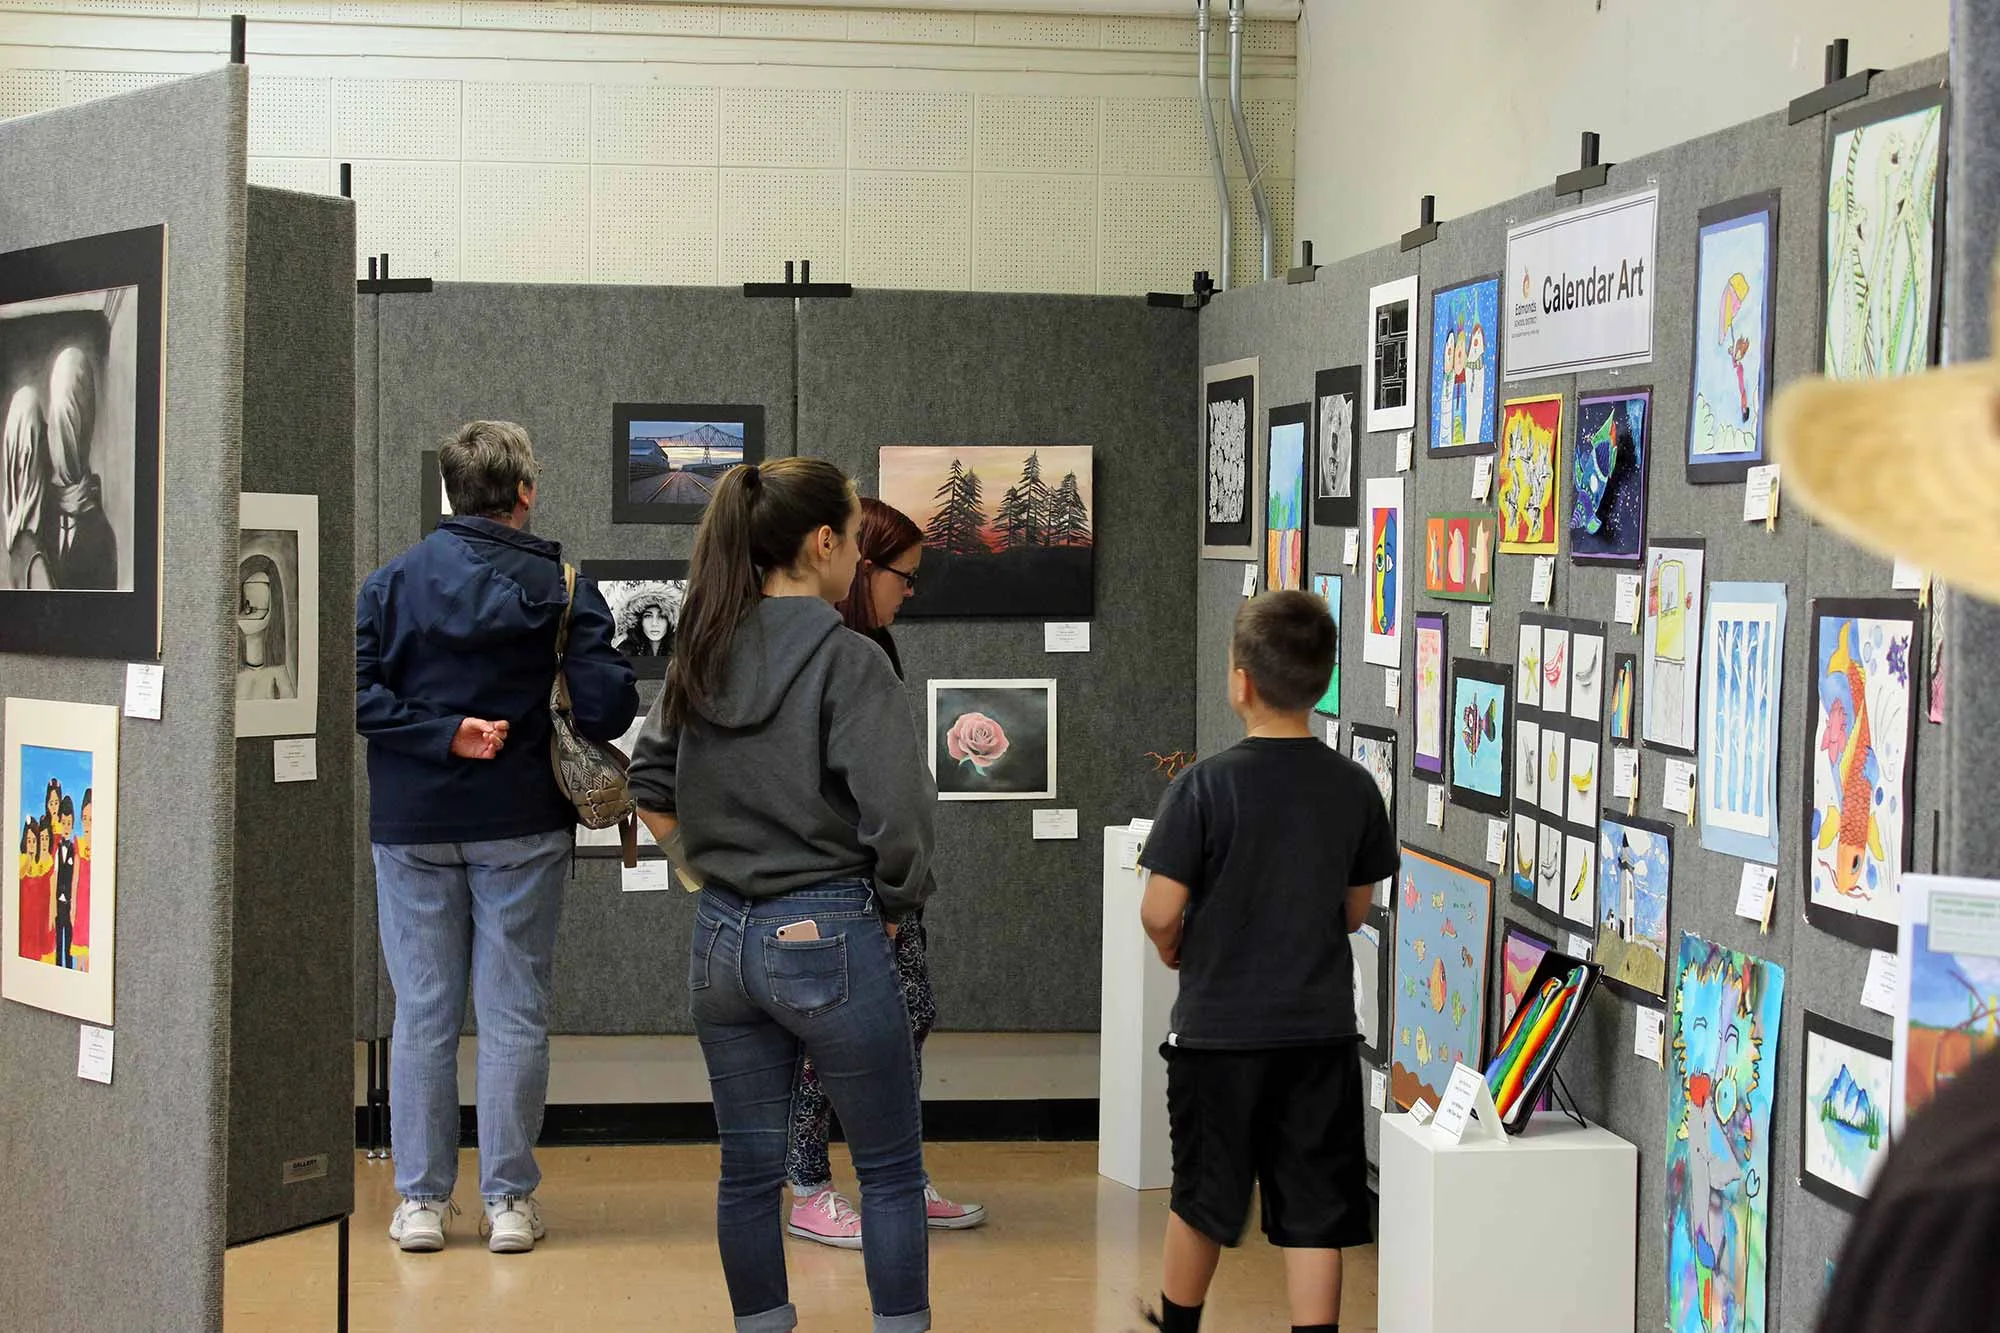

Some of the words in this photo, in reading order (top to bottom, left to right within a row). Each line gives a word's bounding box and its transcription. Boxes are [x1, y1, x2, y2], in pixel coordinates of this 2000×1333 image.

[1542, 265, 1615, 314] Calendar
[1617, 257, 1644, 300] Art
[1515, 302, 1537, 316] Edmonds
